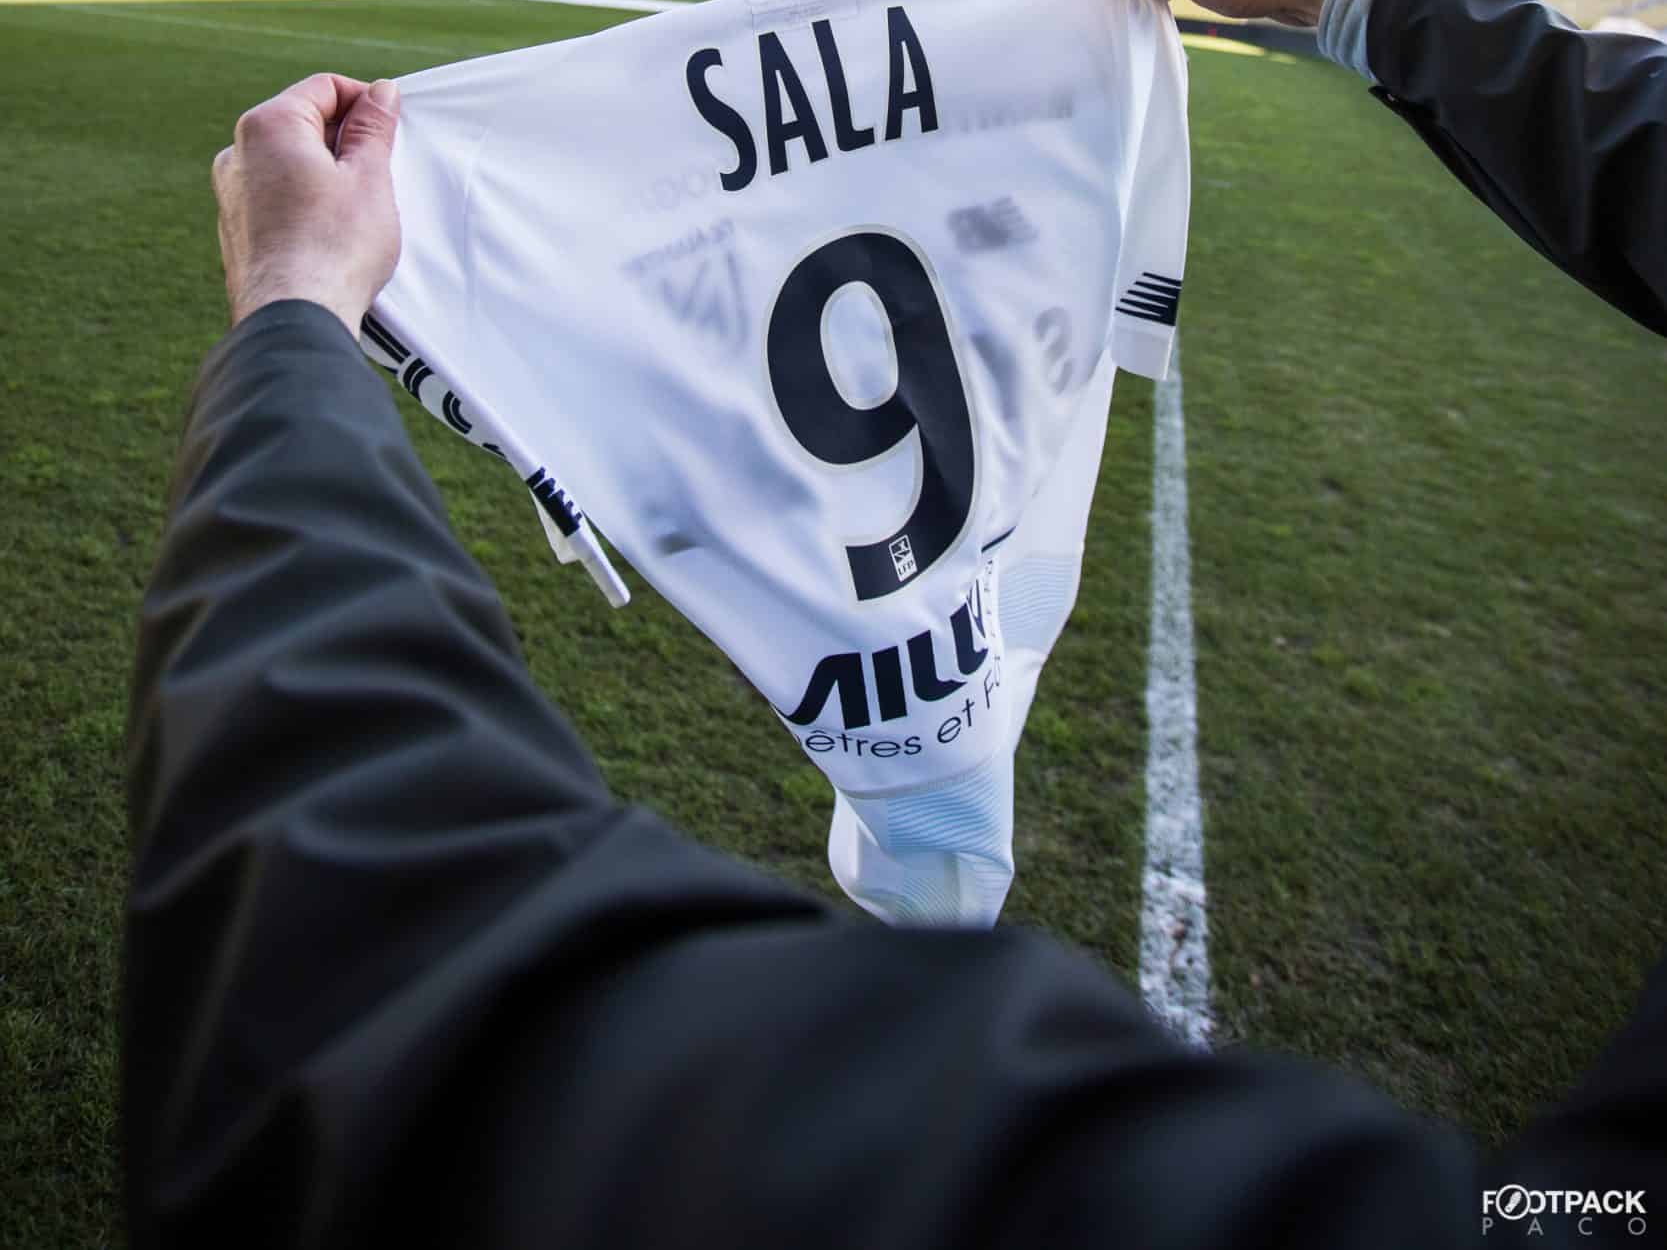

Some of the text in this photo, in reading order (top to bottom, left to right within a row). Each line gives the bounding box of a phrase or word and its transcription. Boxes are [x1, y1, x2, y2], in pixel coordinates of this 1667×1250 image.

[686, 5, 939, 192] SALA
[766, 231, 976, 602] 9
[797, 728, 923, 758] êtres
[937, 698, 976, 744] et
